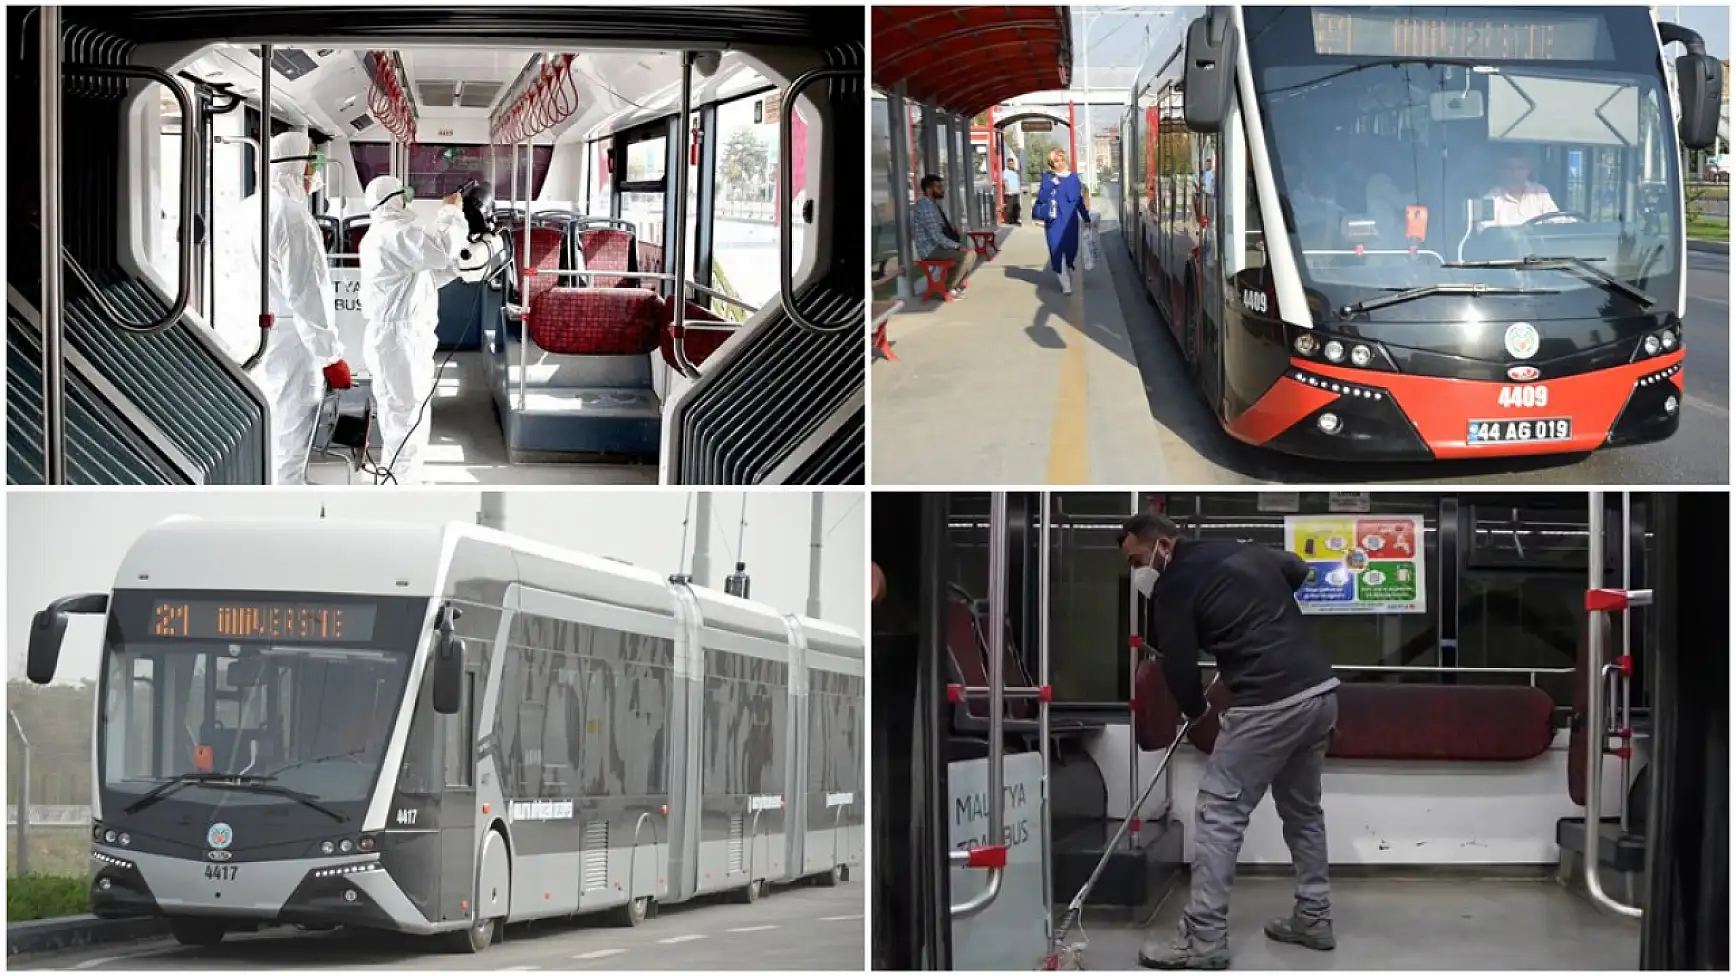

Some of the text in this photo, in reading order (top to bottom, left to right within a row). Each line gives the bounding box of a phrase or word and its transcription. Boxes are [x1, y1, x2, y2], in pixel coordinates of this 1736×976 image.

[1243, 288, 1268, 312] 4409
[1498, 384, 1548, 407] 4409
[1477, 420, 1569, 440] 44 AG 019
[155, 603, 189, 636] 21
[395, 808, 418, 825] 4417
[204, 864, 240, 881] 4417
